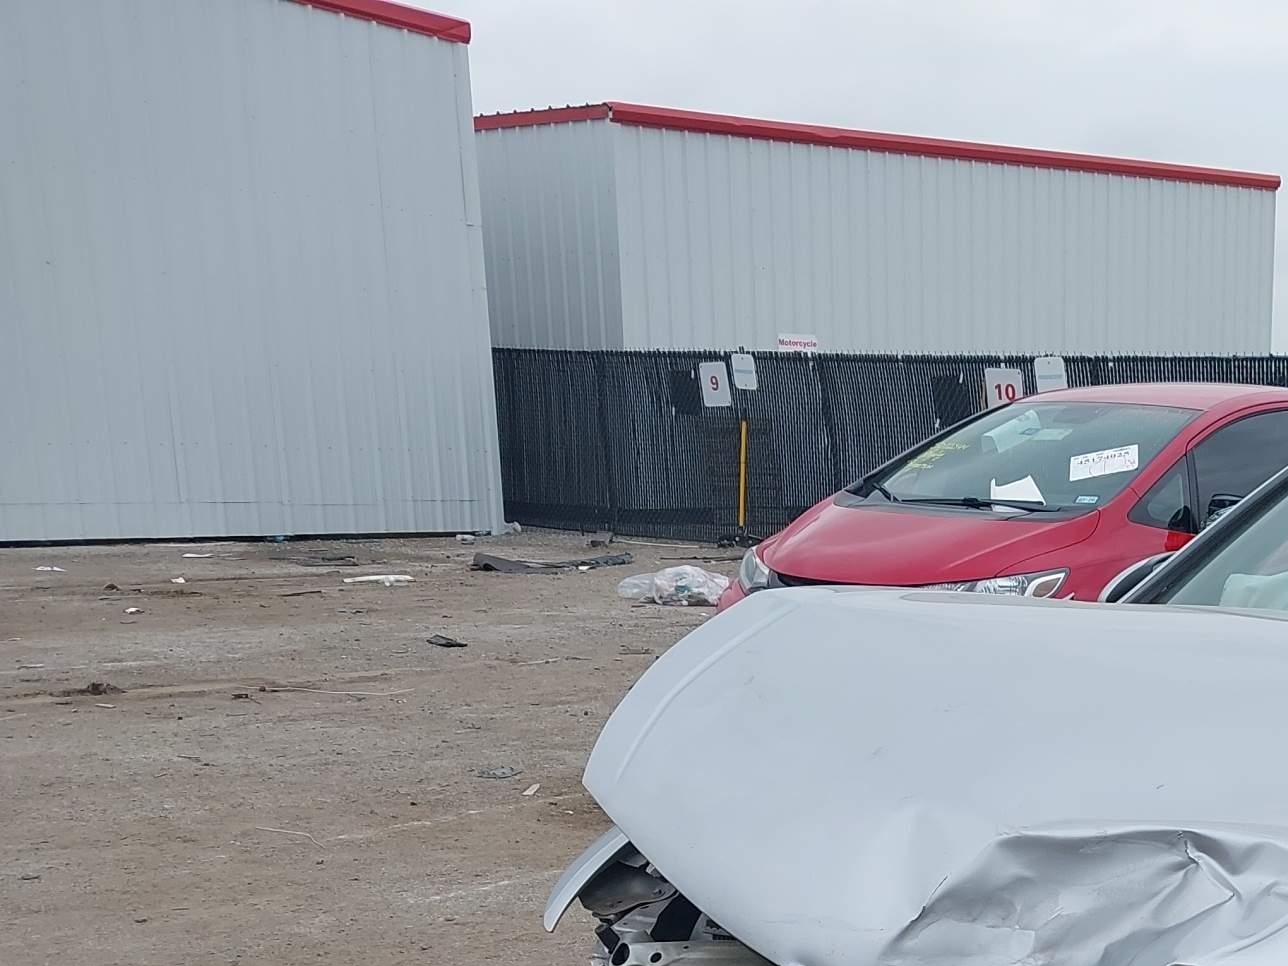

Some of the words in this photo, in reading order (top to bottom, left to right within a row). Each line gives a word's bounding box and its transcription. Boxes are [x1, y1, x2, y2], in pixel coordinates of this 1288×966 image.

[778, 338, 817, 348] Motorcycle
[709, 375, 720, 391] 9
[994, 383, 1016, 401] 10
